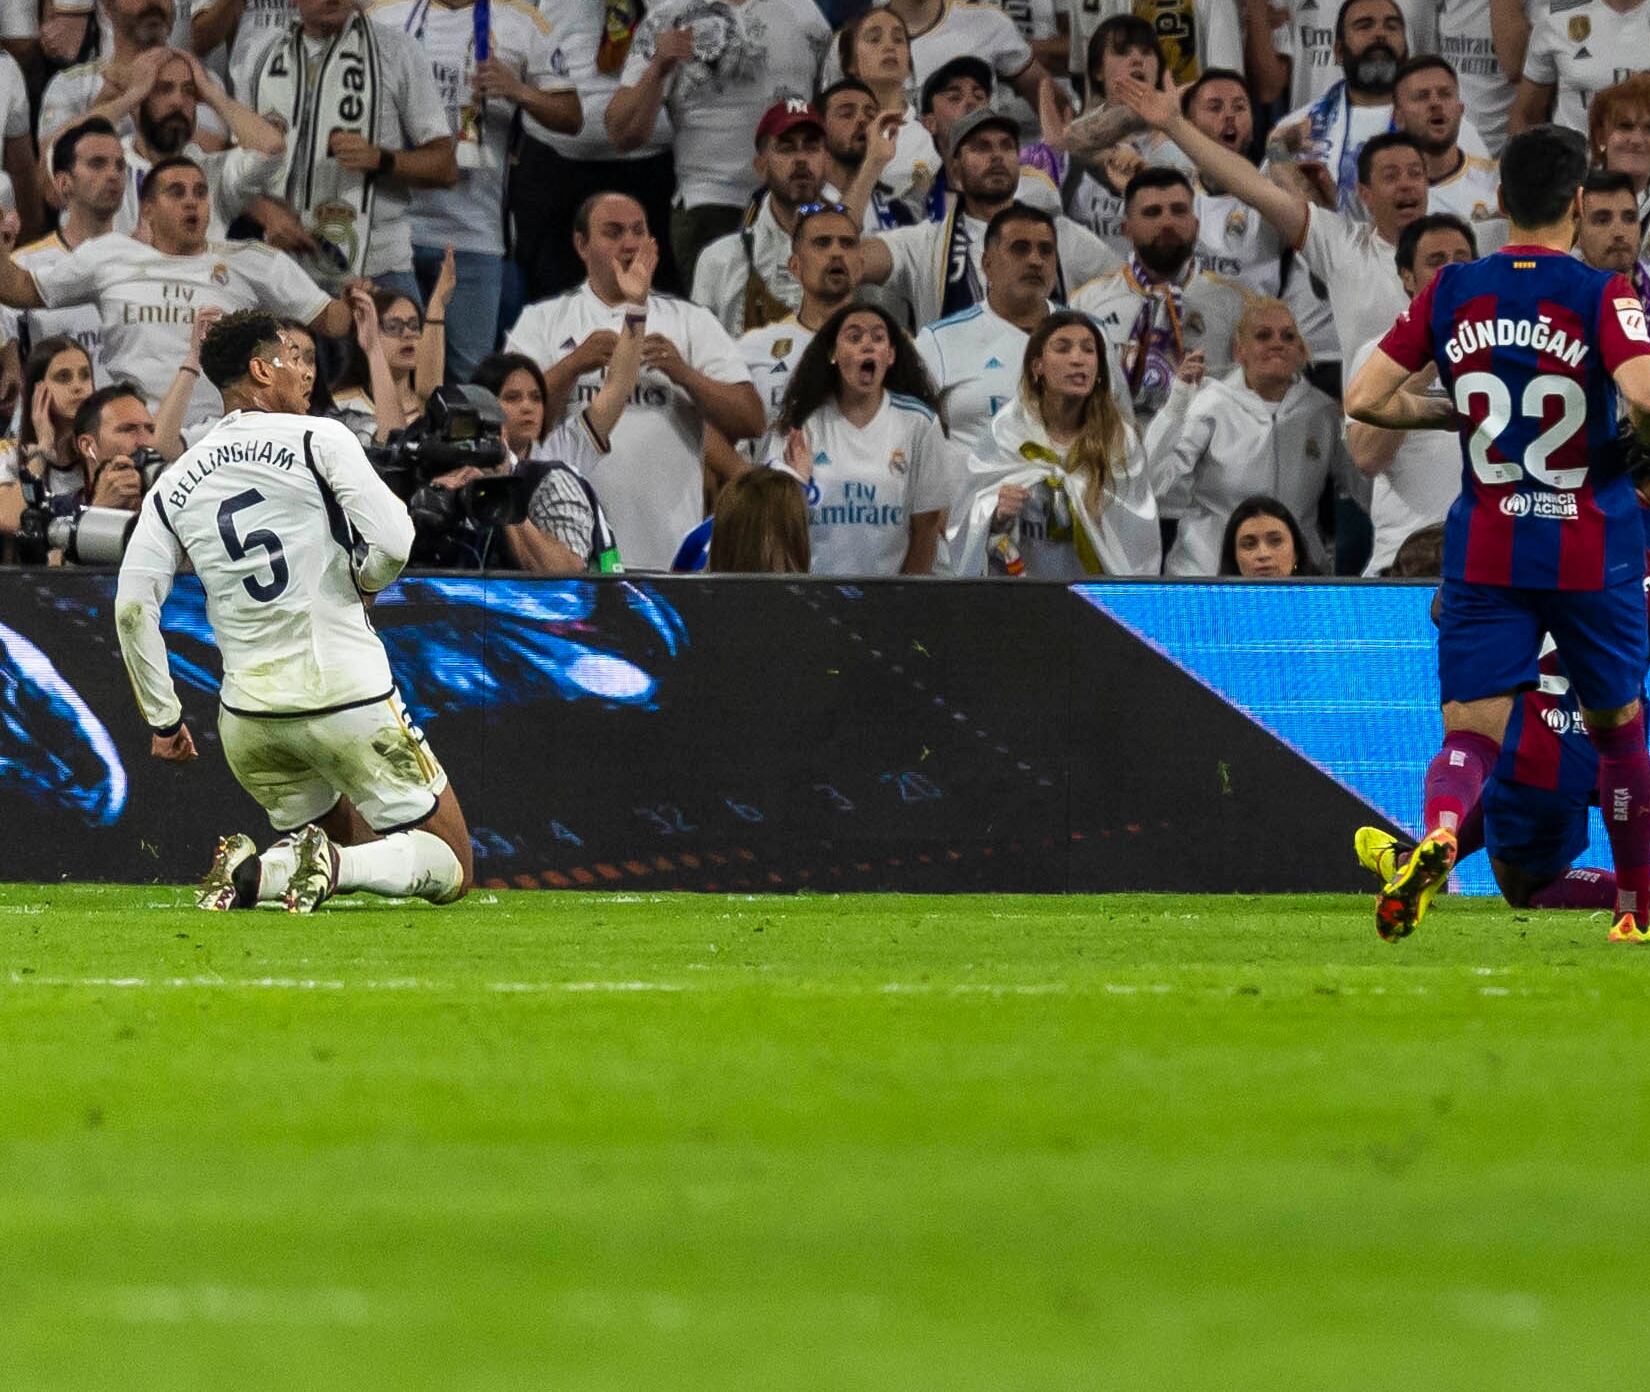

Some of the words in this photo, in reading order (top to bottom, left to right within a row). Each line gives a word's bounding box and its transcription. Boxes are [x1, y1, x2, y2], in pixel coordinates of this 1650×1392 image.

[1445, 314, 1590, 368] GÜNDOĞAN
[1456, 370, 1589, 490] 22
[168, 439, 297, 510] BELLINGHAM
[843, 481, 876, 503] Fly
[216, 486, 291, 606] 5
